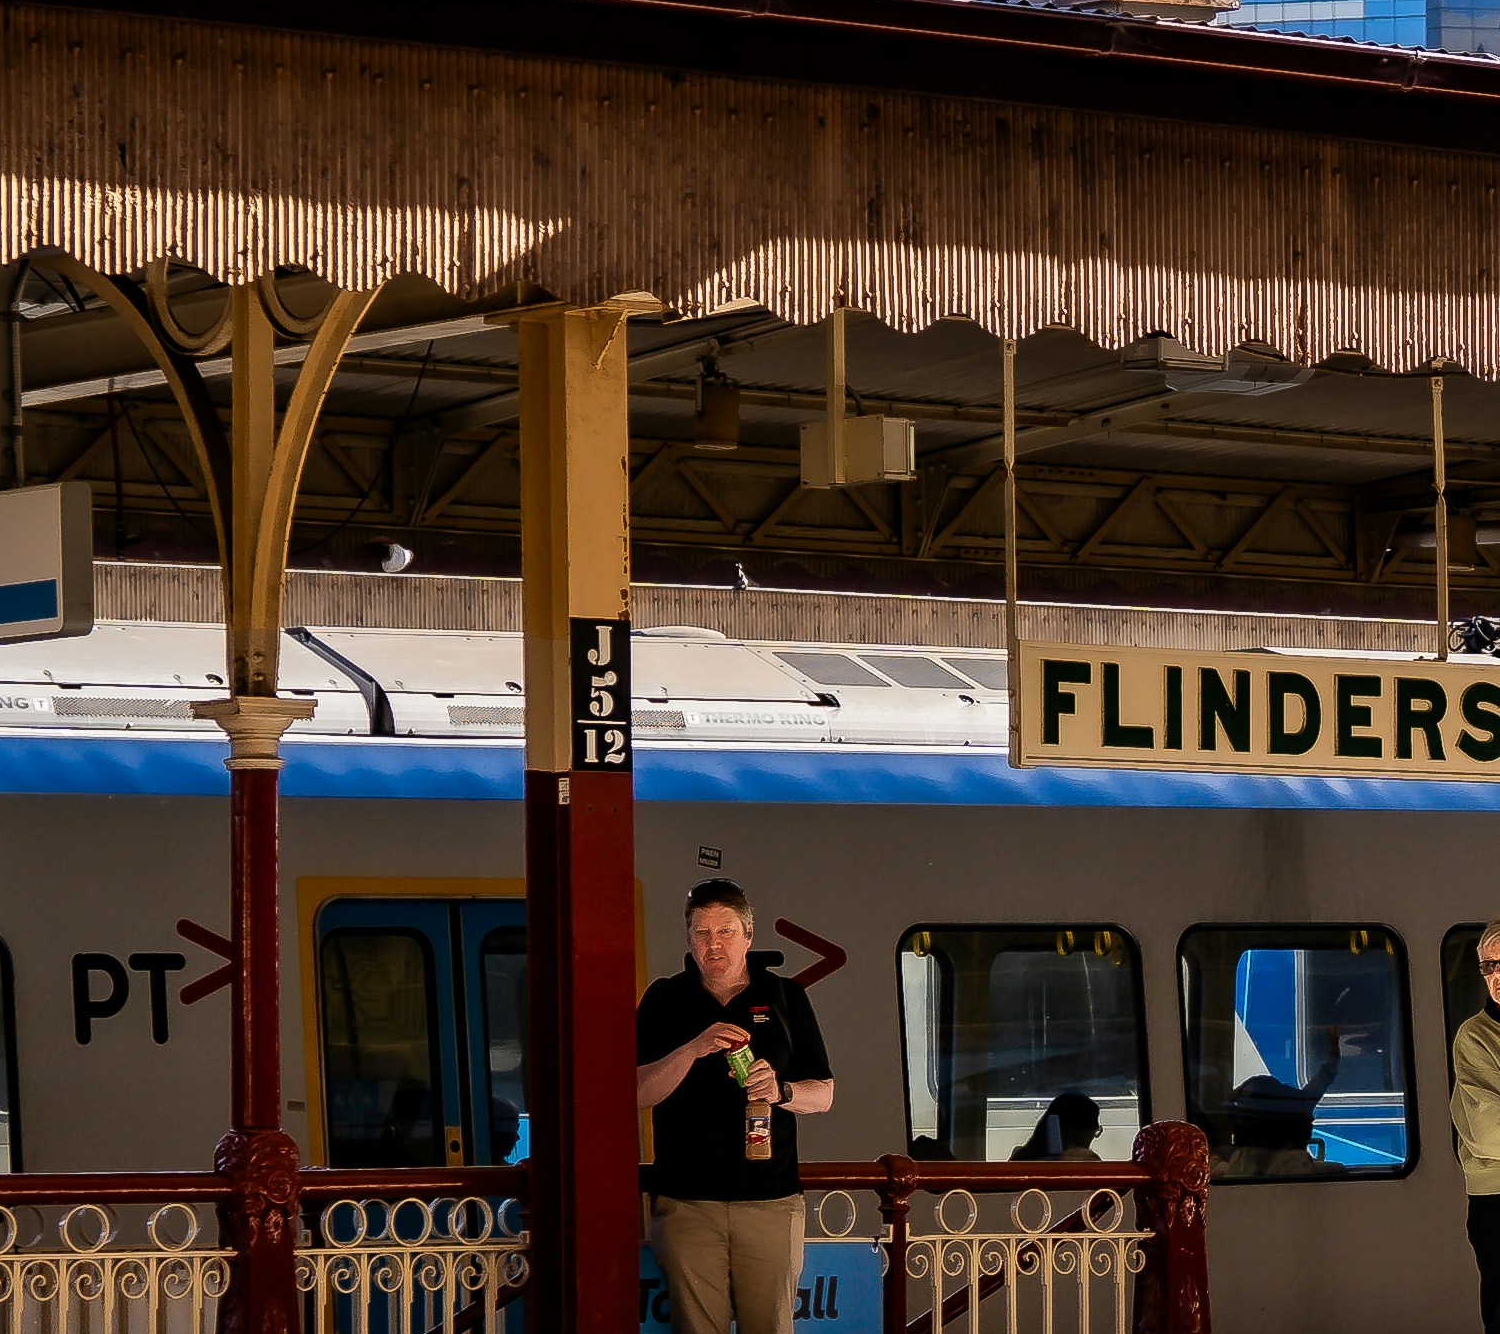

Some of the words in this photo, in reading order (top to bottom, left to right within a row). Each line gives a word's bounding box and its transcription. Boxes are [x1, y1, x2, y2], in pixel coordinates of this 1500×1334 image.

[587, 625, 613, 666] J
[589, 670, 618, 717] 5
[701, 710, 775, 725] THERMO
[778, 712, 826, 727] KING
[583, 729, 626, 764] 12
[793, 1275, 840, 1321] all
